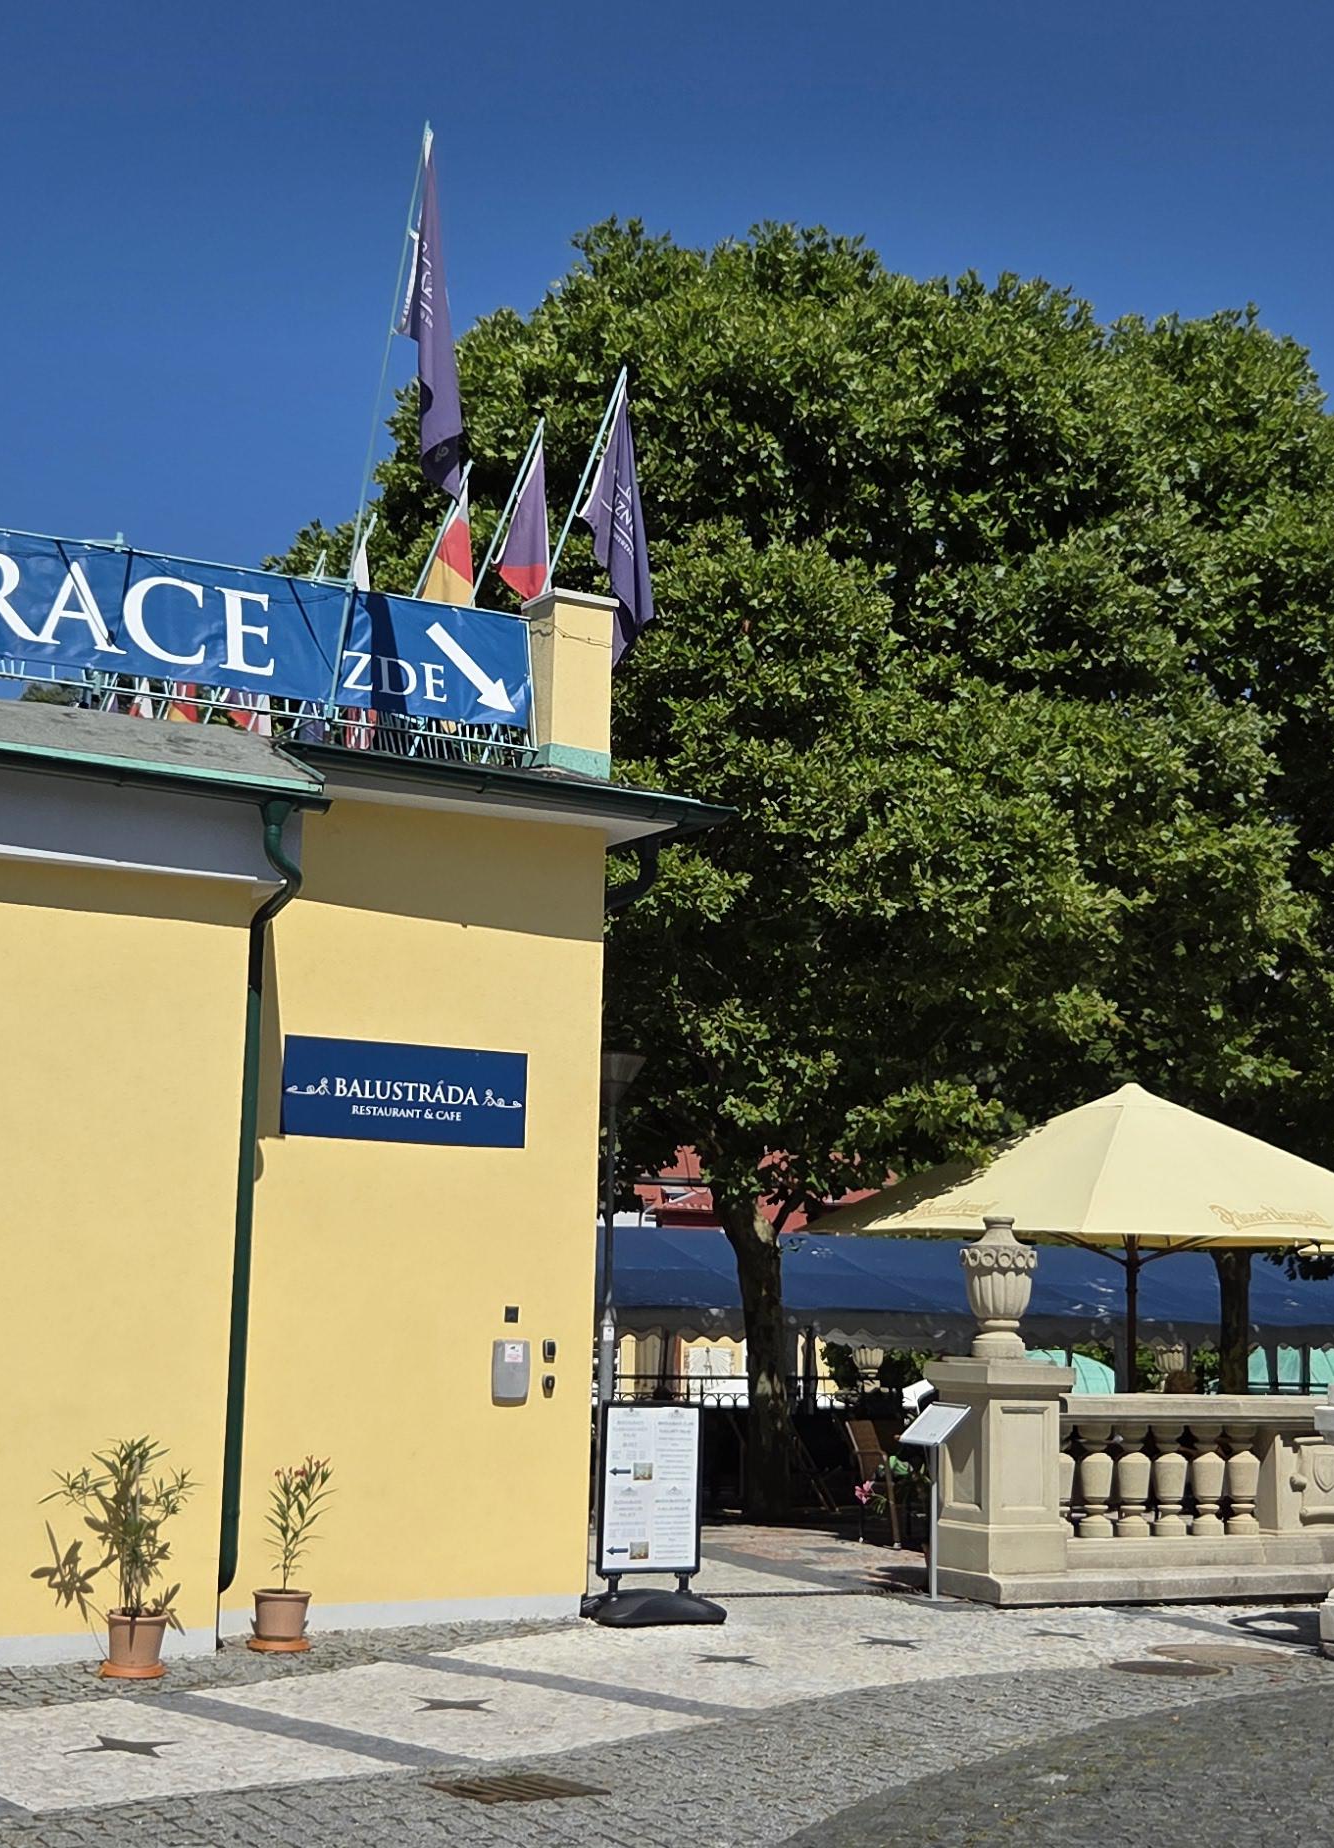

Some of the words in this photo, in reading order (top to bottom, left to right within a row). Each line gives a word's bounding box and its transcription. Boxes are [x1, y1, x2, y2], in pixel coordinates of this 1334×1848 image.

[340, 649, 448, 704] ZDE
[333, 1077, 480, 1107] BALUSTRÁDA
[351, 1104, 422, 1120] RESTAURANT
[423, 1108, 434, 1120] &
[435, 1110, 462, 1122] CAFE
